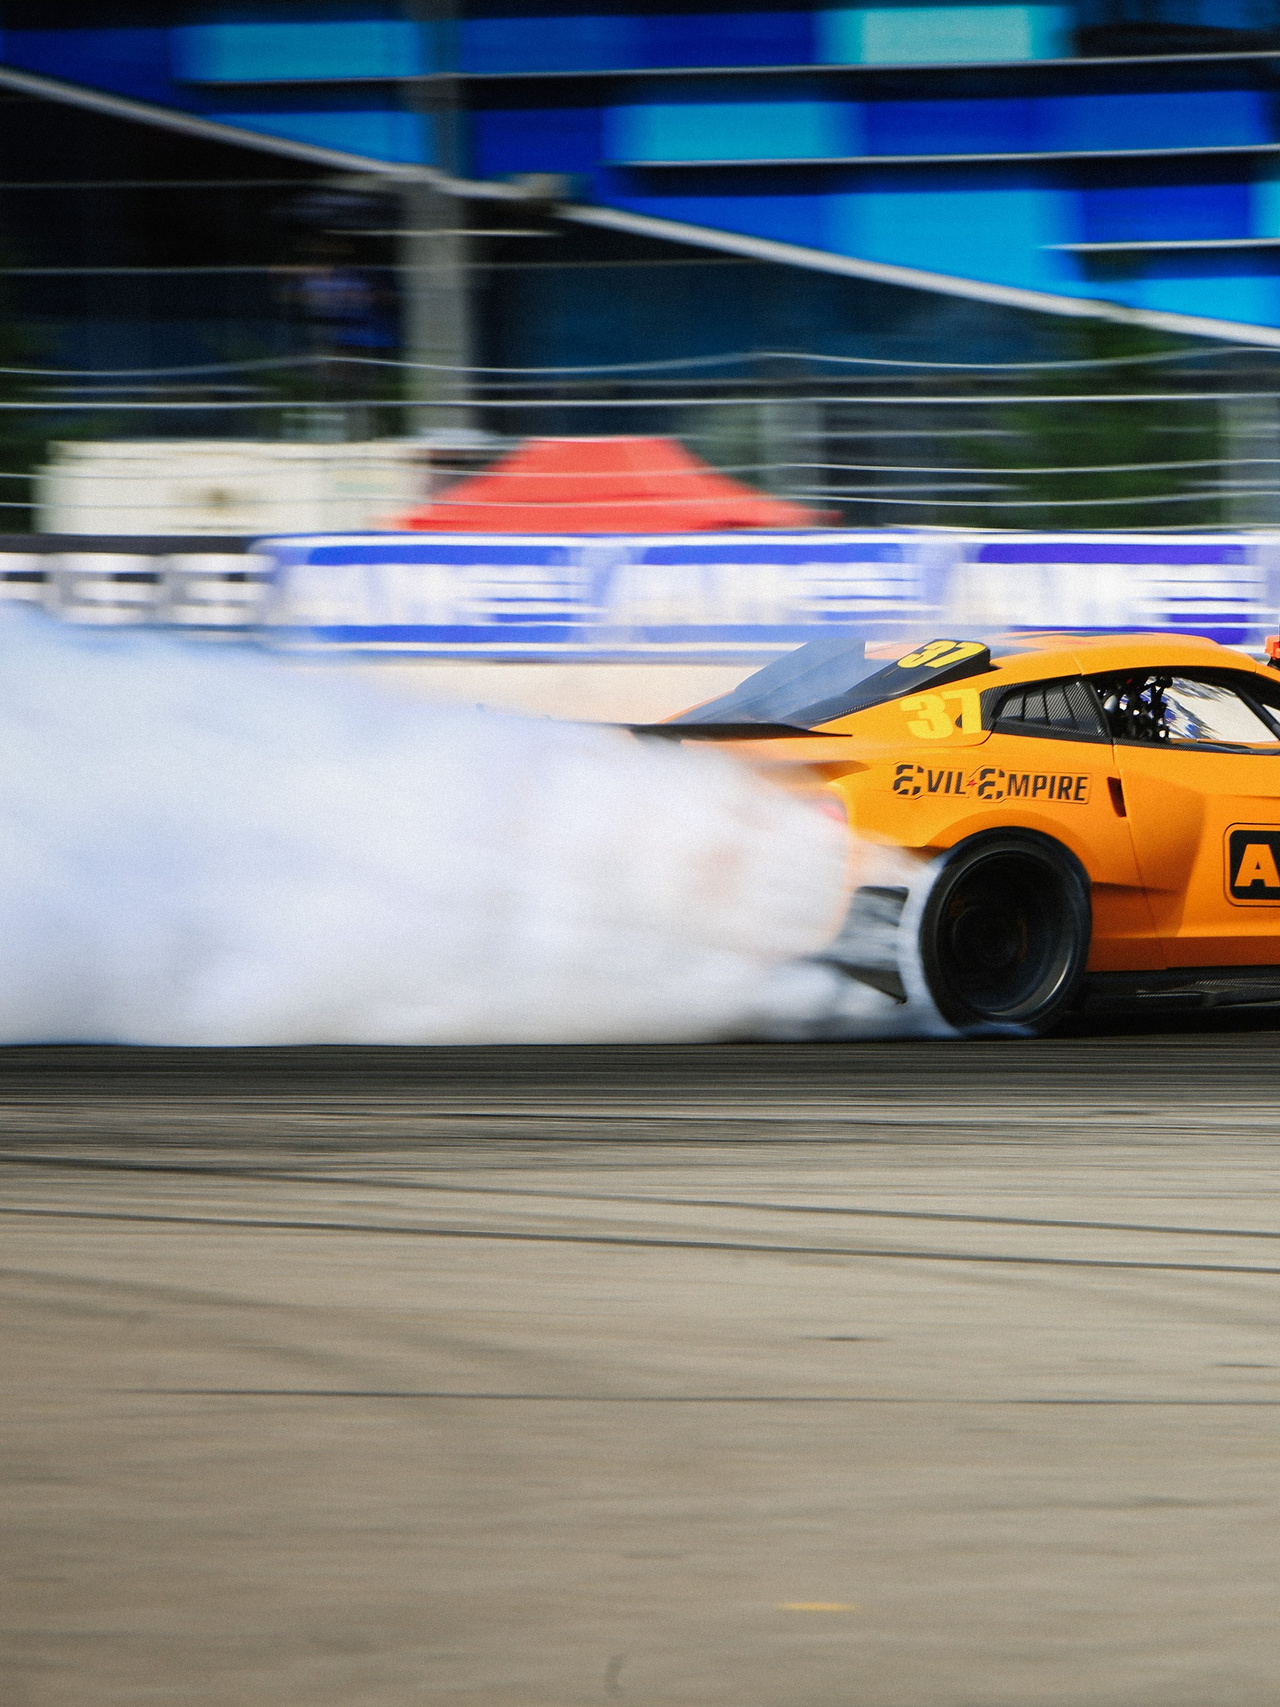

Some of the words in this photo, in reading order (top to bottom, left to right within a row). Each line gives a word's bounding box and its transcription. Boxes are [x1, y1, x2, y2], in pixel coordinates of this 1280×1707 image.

[897, 640, 987, 669] 37
[899, 687, 982, 739] 37
[893, 763, 967, 796] EVIL
[977, 767, 1089, 801] EMPIRE
